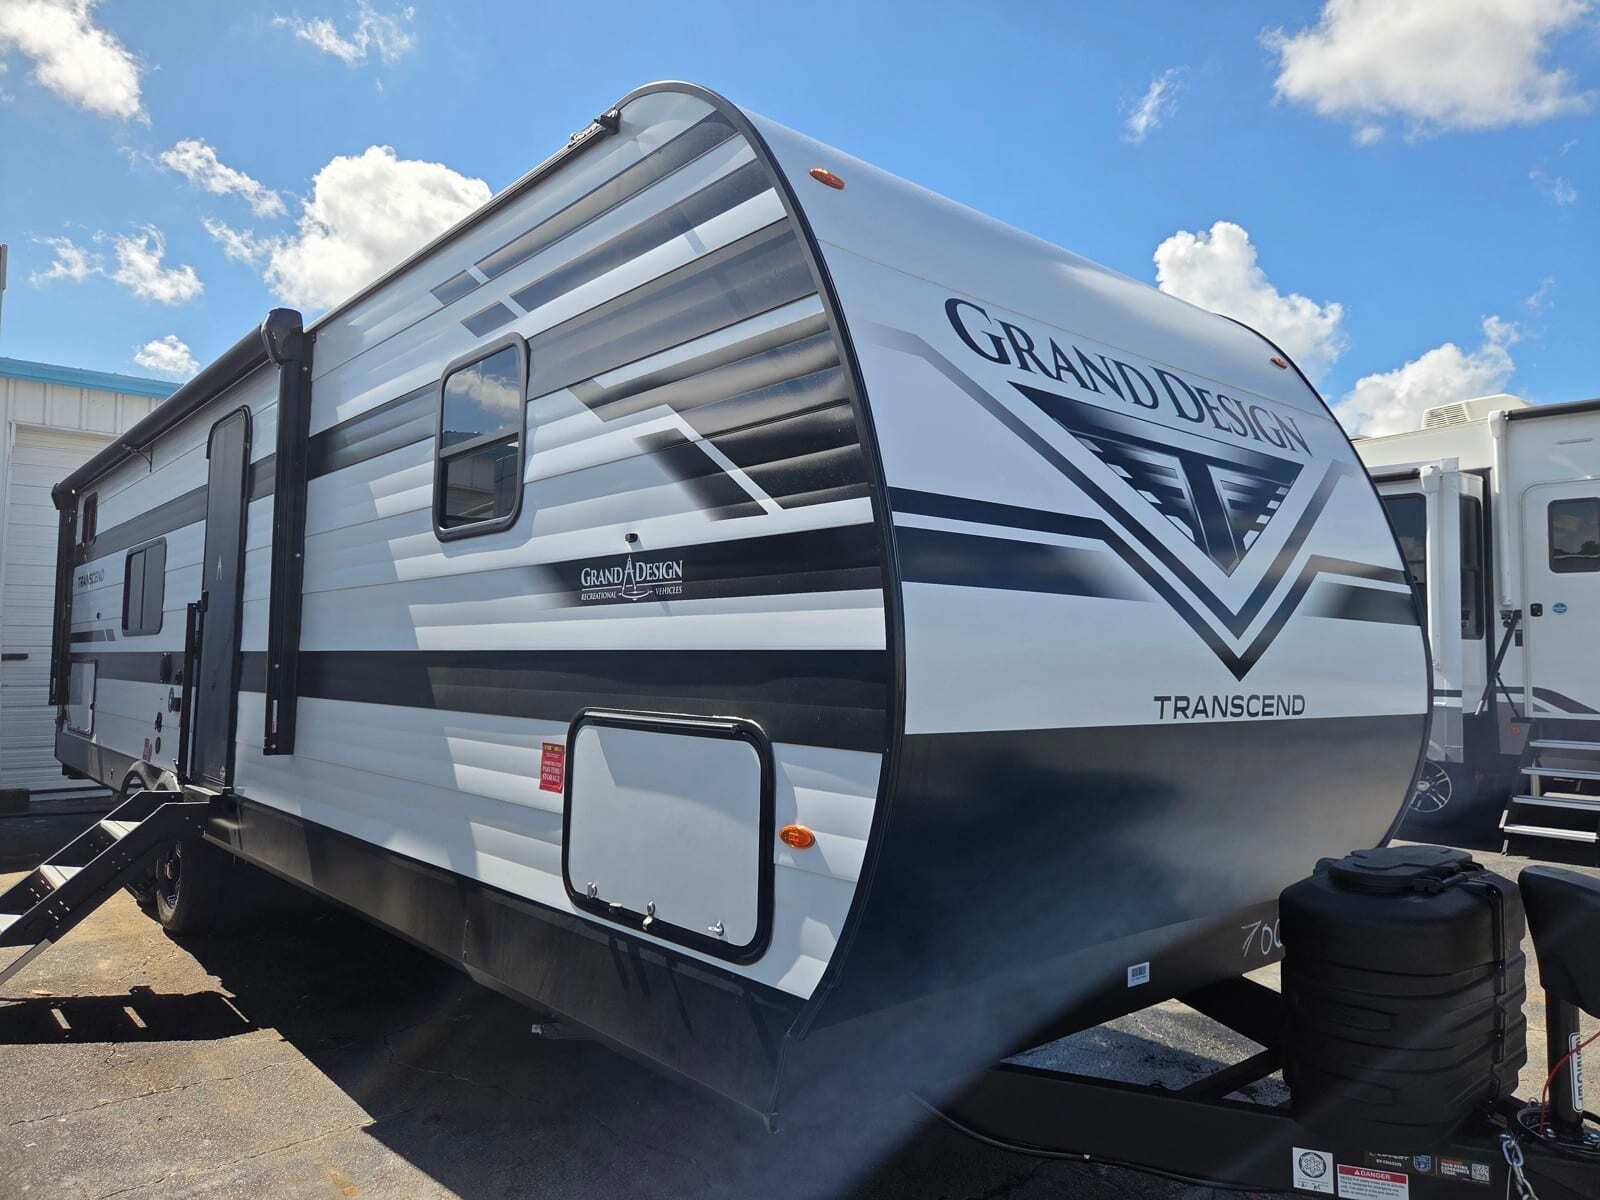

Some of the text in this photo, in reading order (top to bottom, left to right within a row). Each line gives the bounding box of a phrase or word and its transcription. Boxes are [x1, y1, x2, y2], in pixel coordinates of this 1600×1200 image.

[944, 298, 1313, 457] GRAND DESIGN
[581, 560, 683, 587] GRAND DESIGN
[581, 586, 683, 601] RECREATIONAL VEHICLES
[1153, 694, 1306, 720] TRANSCEND
[1360, 1170, 1391, 1181] DANGER
